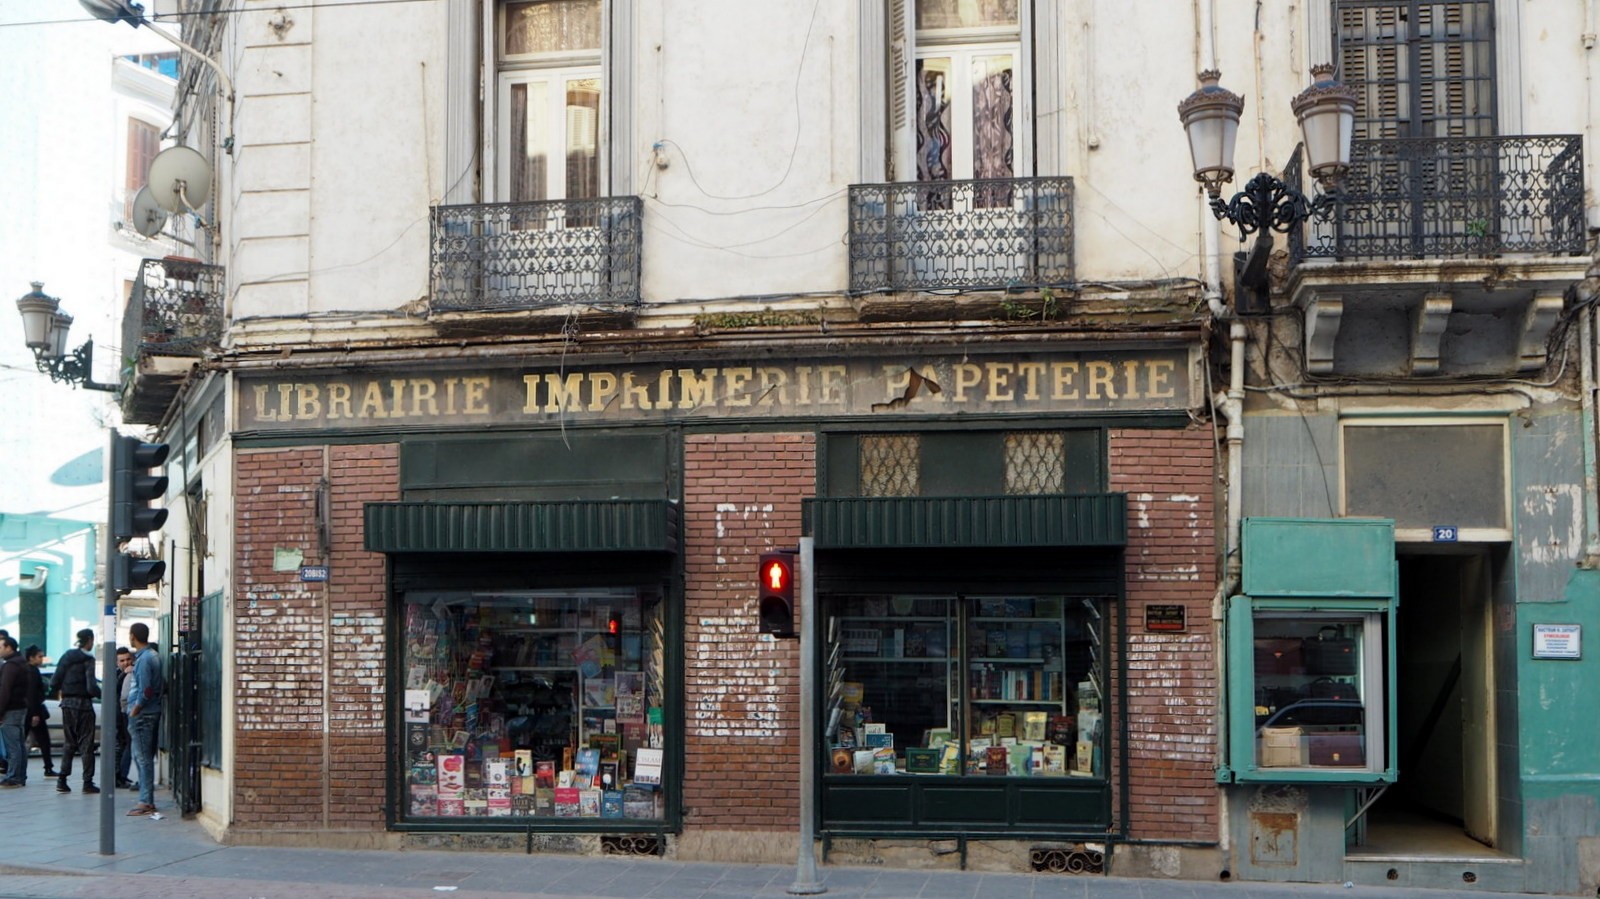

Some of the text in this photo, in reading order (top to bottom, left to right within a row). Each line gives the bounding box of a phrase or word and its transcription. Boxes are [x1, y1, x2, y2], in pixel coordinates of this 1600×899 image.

[254, 377, 491, 422] LIBRAIRIE
[522, 365, 848, 414] IMPRIMERIE
[1438, 529, 1453, 539] 20
